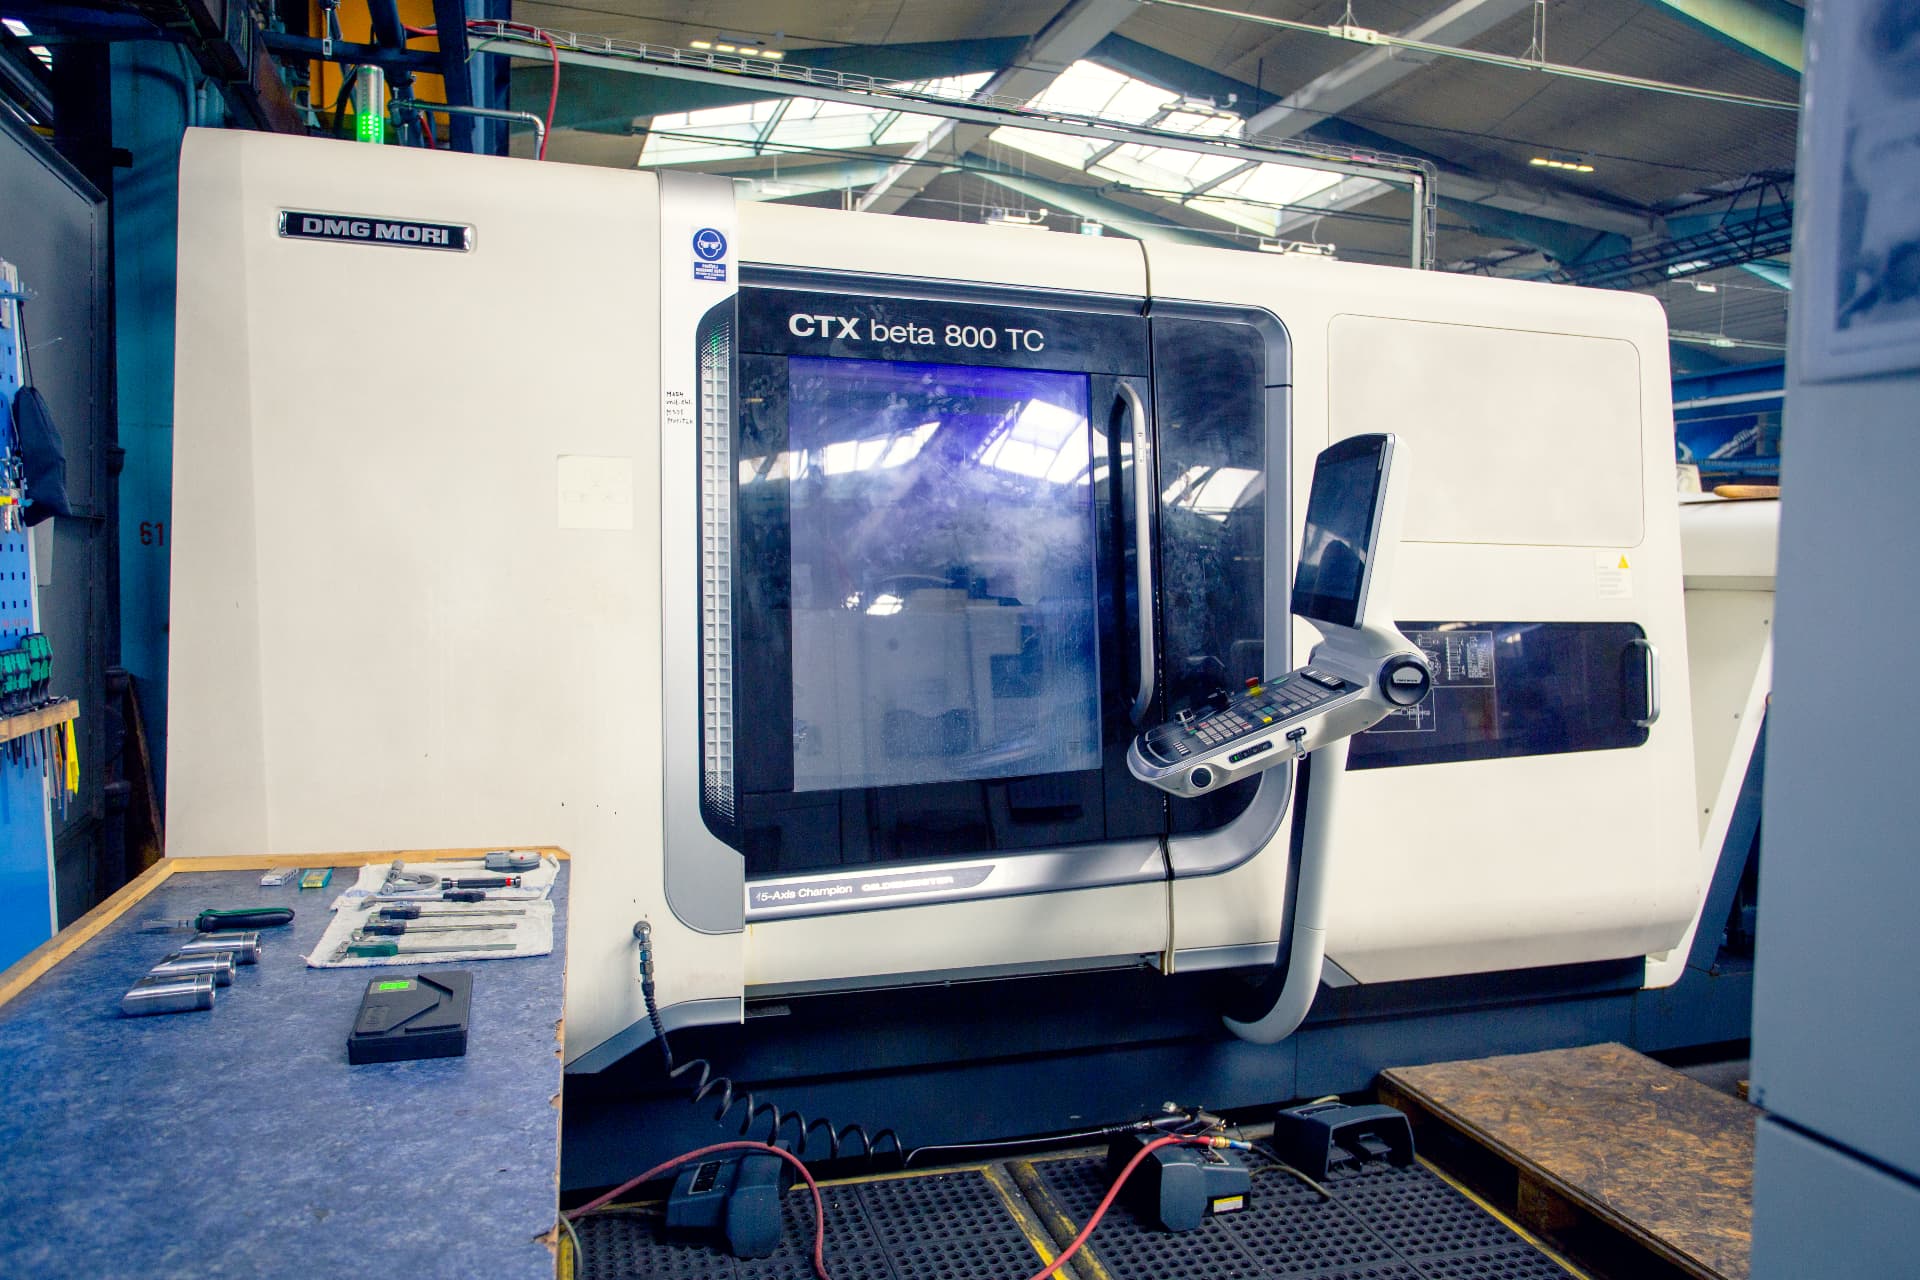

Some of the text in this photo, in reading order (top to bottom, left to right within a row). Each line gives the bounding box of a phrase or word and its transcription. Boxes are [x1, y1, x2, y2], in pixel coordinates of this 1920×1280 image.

[302, 217, 450, 245] DMG MORI
[788, 313, 1045, 352] CTX beta 800 TC
[139, 521, 164, 547] 61
[798, 884, 853, 899] Champion
